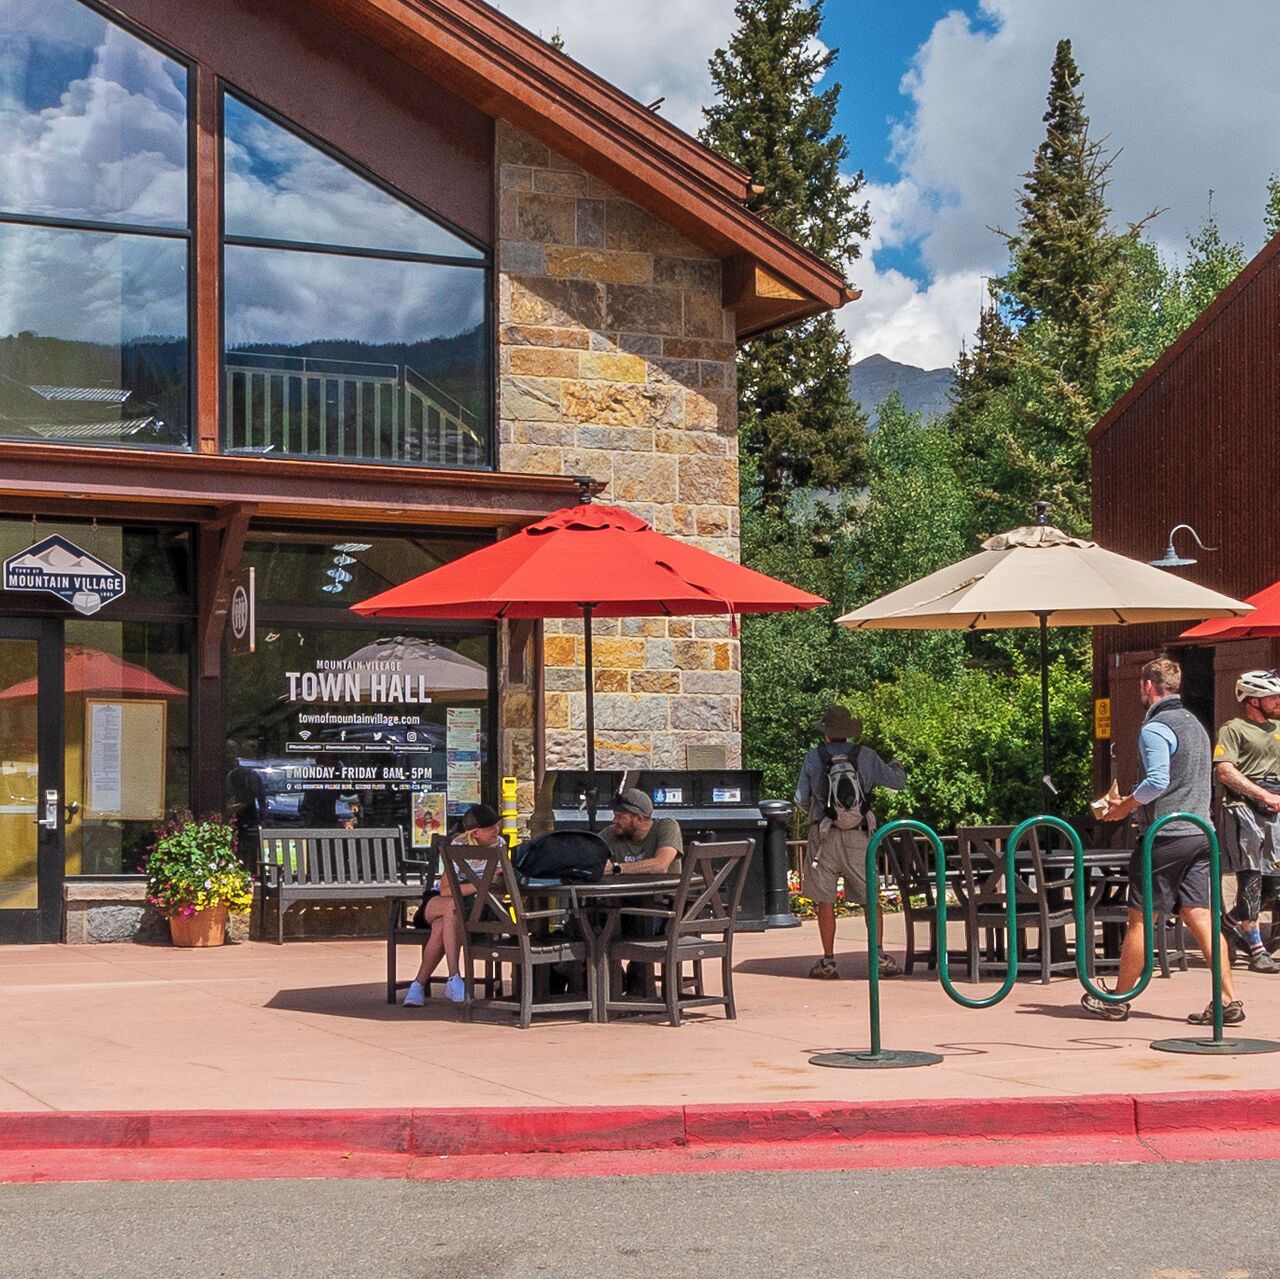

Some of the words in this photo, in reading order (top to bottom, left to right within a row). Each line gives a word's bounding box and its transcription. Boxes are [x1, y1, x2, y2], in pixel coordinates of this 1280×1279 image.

[8, 574, 69, 588] MOUNTAIN
[73, 577, 121, 590] VILLAGE
[316, 659, 362, 670] MOUNTAIN
[363, 660, 402, 671] VILLAGE
[285, 672, 360, 702] TOWN
[370, 673, 432, 703] HALL
[298, 712, 420, 726] townofmountainvillage.com
